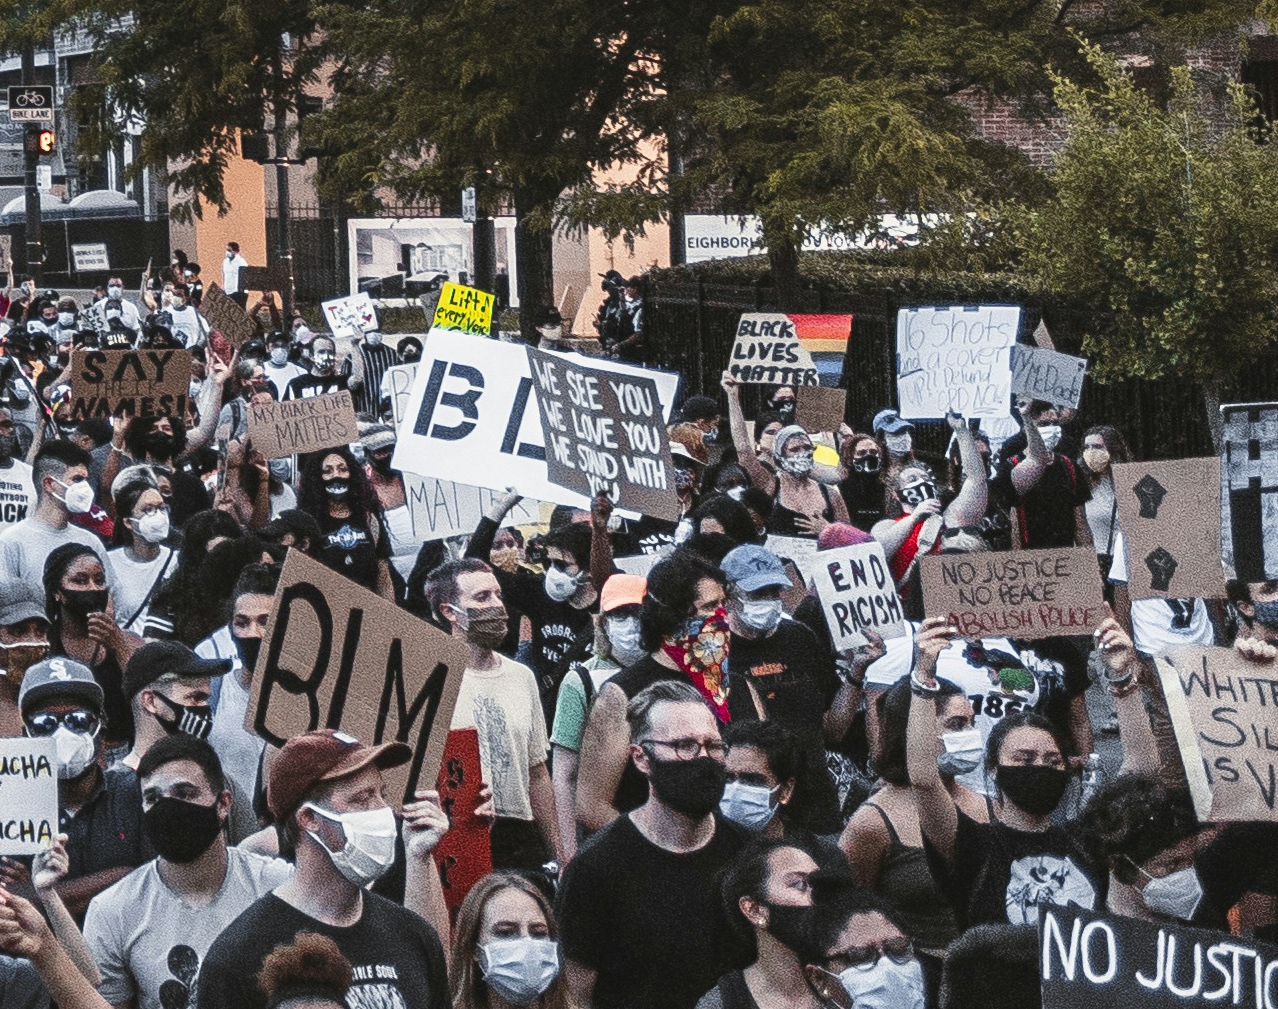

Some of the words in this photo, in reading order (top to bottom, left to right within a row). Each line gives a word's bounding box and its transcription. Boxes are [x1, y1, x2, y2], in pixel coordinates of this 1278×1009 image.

[11, 110, 29, 119] BIKE
[31, 110, 50, 119] LANE
[437, 307, 466, 325] every
[449, 288, 480, 311] Lift
[739, 318, 793, 339] BLACK
[904, 311, 925, 352] 16
[930, 310, 1013, 349] Shots
[80, 350, 173, 385] SAY
[733, 341, 799, 363] LIVES
[926, 351, 941, 371] a
[944, 345, 1008, 366] cover
[532, 357, 561, 396] WE
[565, 369, 604, 411] SEE
[608, 380, 653, 417] YOU
[731, 364, 819, 387] MATTER
[72, 393, 186, 419] NAMES!
[253, 405, 277, 424] MY
[278, 399, 321, 420] BLACK
[322, 392, 352, 413] LIFE
[412, 358, 546, 459] BL
[275, 416, 346, 450] MATTERS
[542, 397, 567, 432] WE
[571, 407, 619, 449] LOVE
[621, 420, 661, 455] YOU
[549, 431, 575, 470] WE
[576, 443, 619, 480] STAND
[621, 454, 667, 491] WITH
[827, 554, 886, 592] END
[941, 562, 984, 585] NO
[985, 556, 1072, 585] JUSTICE
[958, 585, 995, 606] NO
[999, 582, 1059, 605] PEACE
[836, 598, 905, 639] RACISM
[947, 608, 1035, 639] ABOLISH
[1039, 604, 1100, 629] POLICE
[252, 582, 449, 804] BLM
[1204, 756, 1243, 785] IS
[1040, 911, 1118, 985] NO
